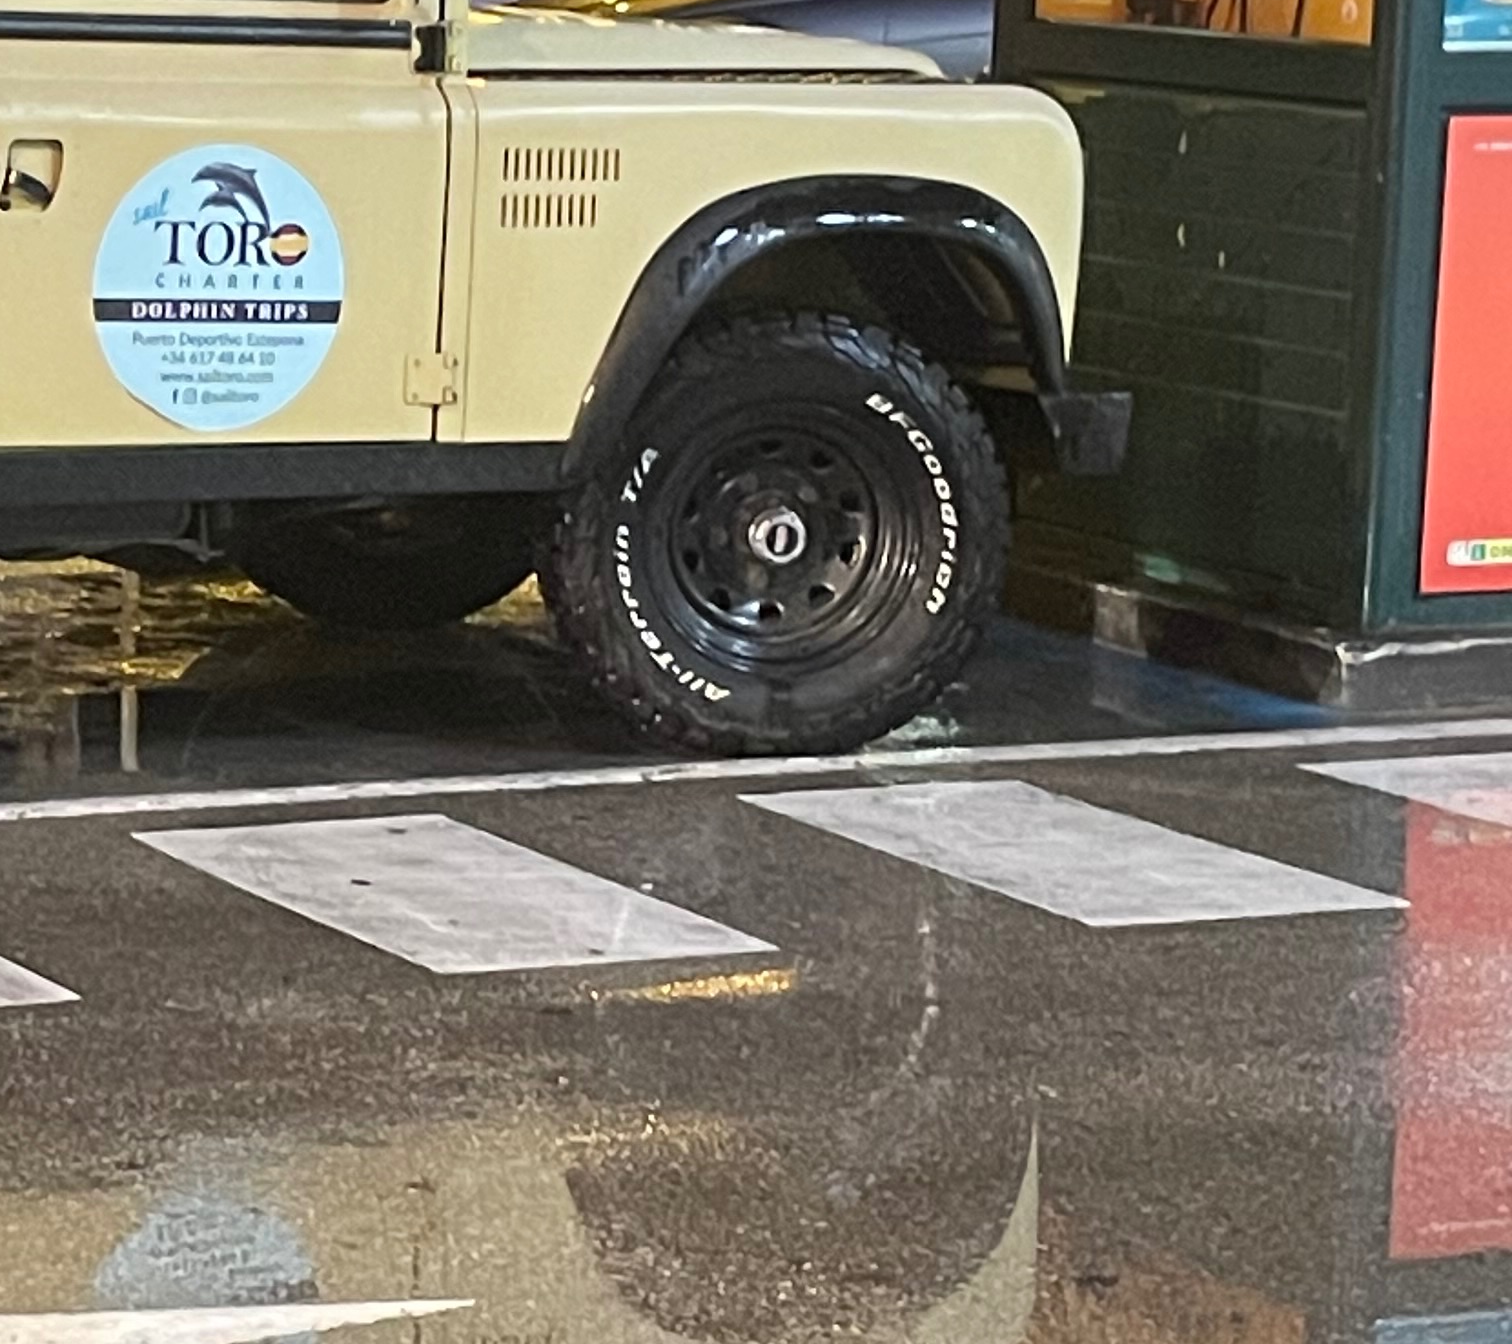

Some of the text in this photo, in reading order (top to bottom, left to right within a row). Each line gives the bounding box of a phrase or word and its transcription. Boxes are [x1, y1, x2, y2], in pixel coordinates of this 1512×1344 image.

[154, 220, 309, 267] TORO
[155, 273, 304, 290] CHARTER
[131, 301, 309, 321] DOLPHIN TRIPS
[133, 330, 176, 346] Puerto
[179, 331, 243, 348] Deportivo
[189, 351, 215, 364] 617
